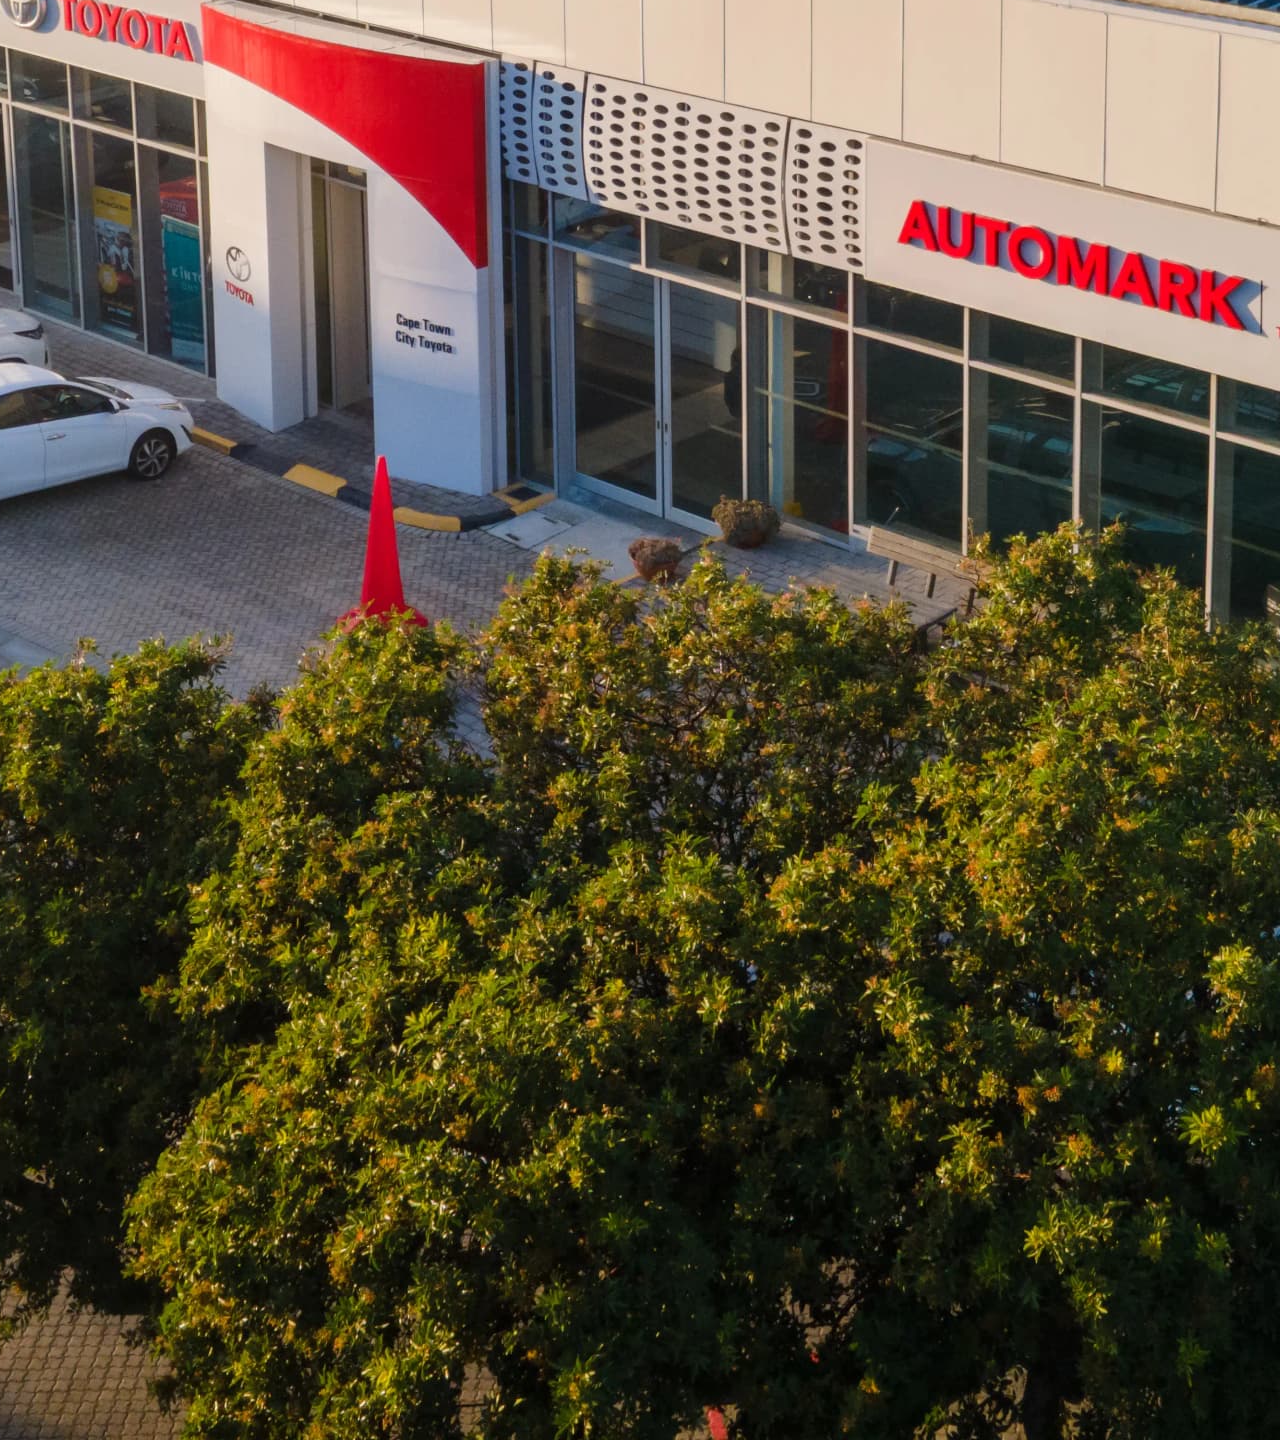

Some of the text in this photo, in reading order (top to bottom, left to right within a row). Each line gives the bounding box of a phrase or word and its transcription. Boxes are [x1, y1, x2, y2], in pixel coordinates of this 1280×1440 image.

[898, 199, 1248, 332] AUTOMARK
[225, 280, 255, 306] TOYOTA
[396, 312, 452, 336] Cape Town
[395, 330, 453, 354] City Toyota
